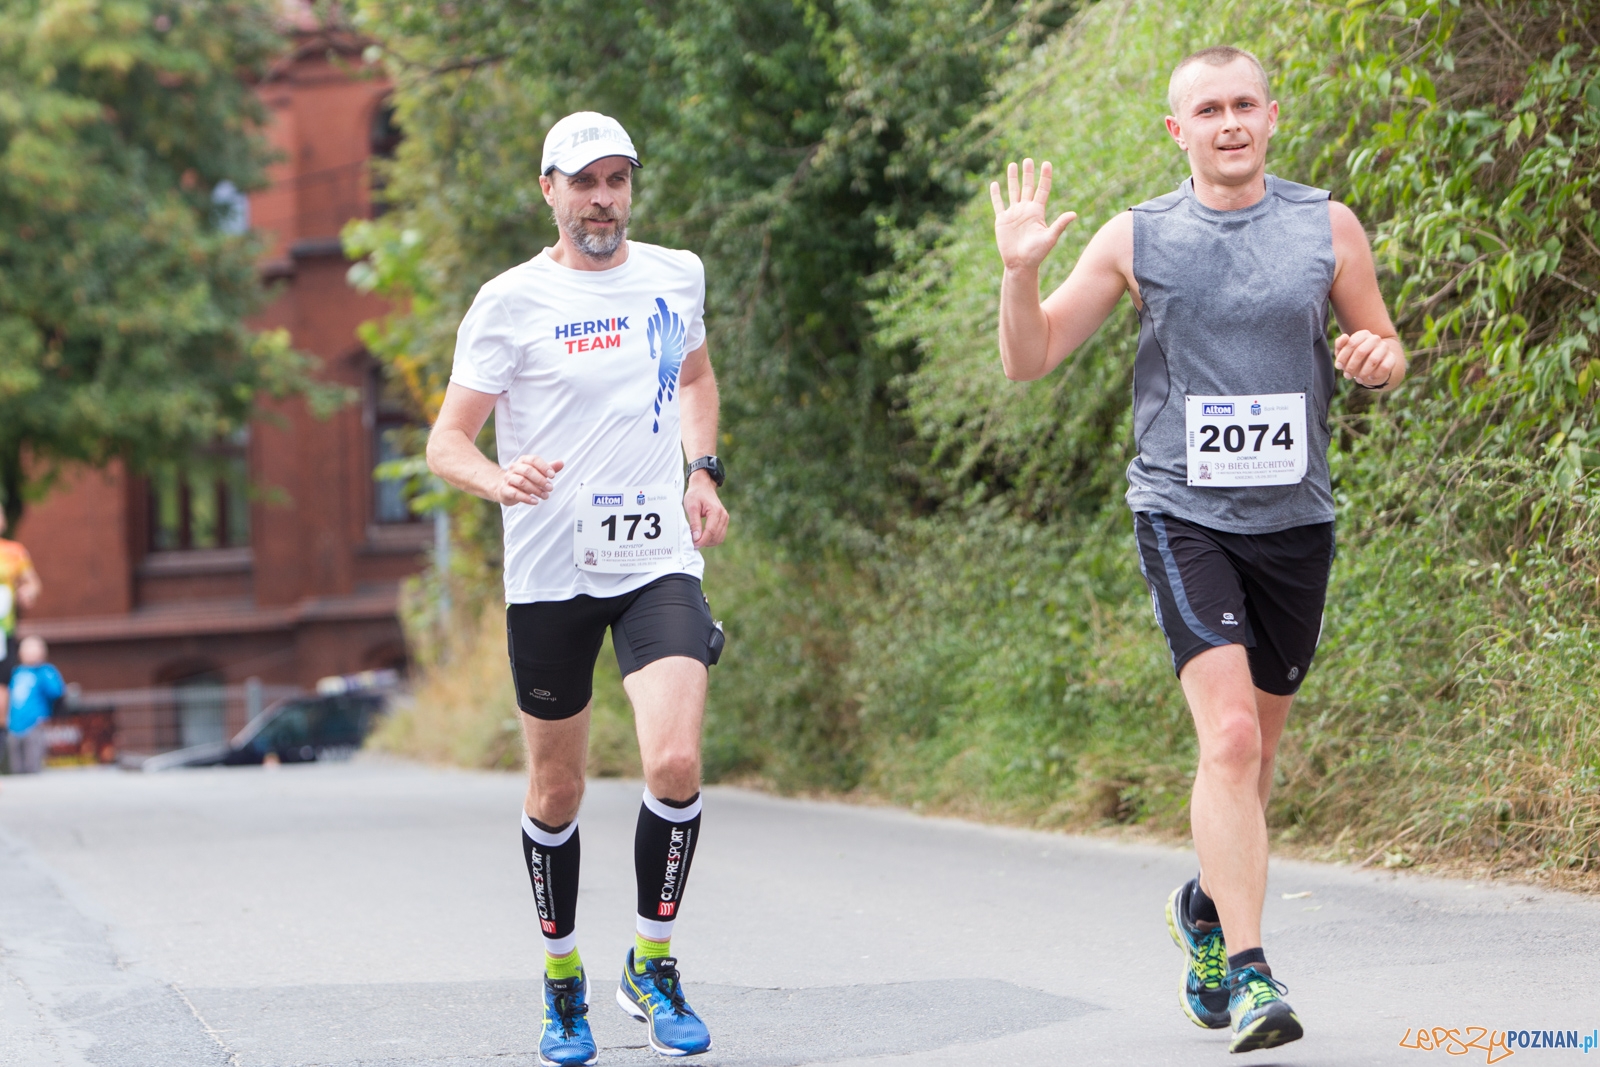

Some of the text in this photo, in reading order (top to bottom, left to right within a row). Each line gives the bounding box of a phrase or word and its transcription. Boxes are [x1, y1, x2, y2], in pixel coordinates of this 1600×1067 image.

[555, 316, 630, 340] HERNIK
[565, 334, 621, 355] TEAM
[1199, 422, 1294, 453] 2074
[1214, 459, 1296, 470] 39 BIEG LECHITÓW
[601, 512, 662, 541] 173
[600, 546, 674, 558] 39 BIEG LECHITÓW
